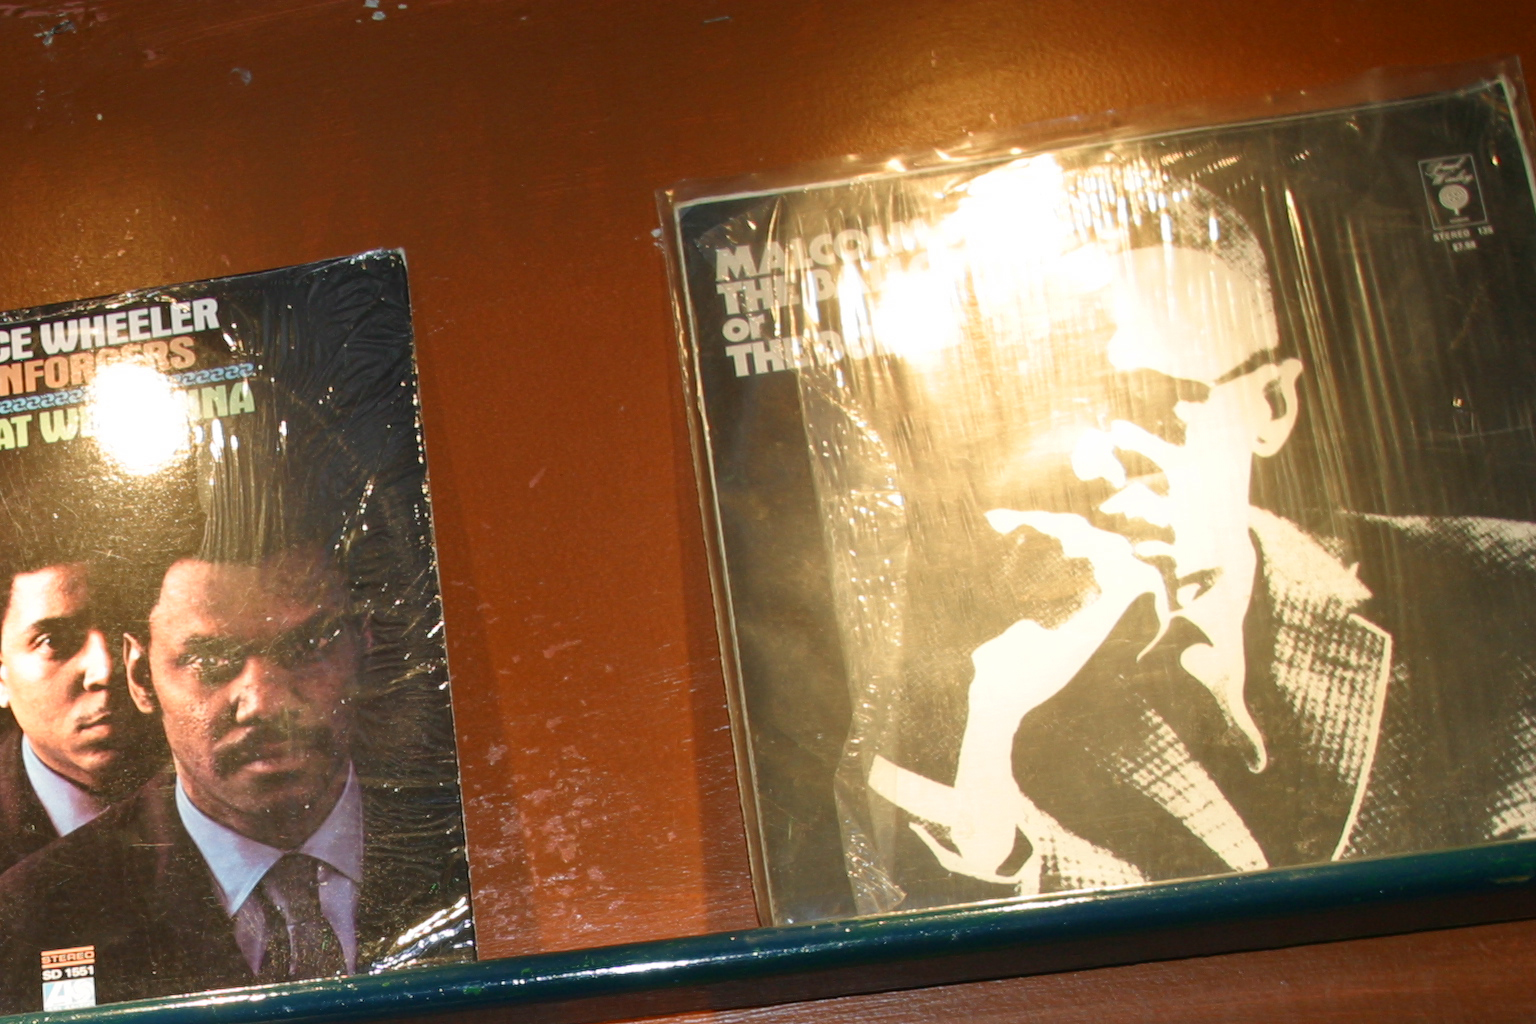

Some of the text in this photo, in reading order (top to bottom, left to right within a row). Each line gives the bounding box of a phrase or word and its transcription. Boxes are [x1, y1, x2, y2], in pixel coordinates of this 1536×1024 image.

[717, 274, 801, 315] THE
[40, 298, 220, 354] WHEELER
[41, 950, 95, 964] STEREO
[42, 965, 94, 980] SD 1551
